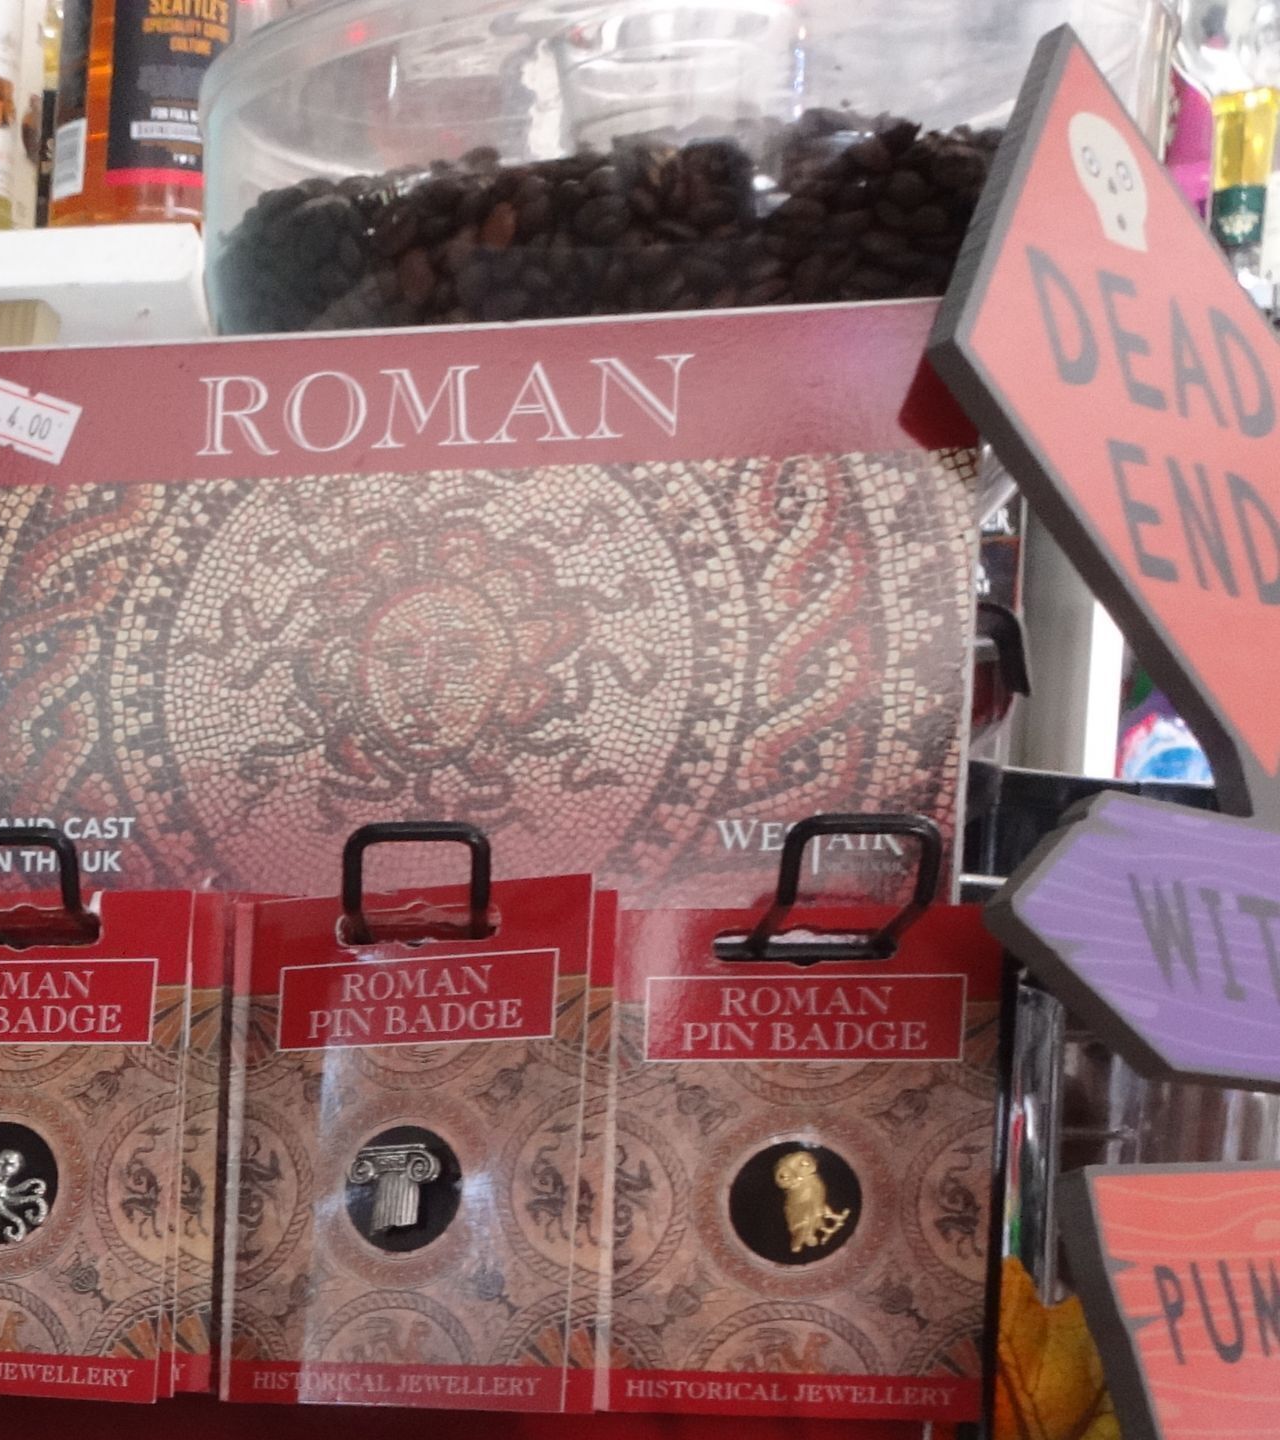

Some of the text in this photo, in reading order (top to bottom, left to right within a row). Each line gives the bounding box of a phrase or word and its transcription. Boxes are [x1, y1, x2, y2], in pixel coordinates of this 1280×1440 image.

[1025, 246, 1277, 439] DEAD
[197, 353, 696, 457] ROMAN
[1106, 439, 1280, 606] END
[64, 817, 136, 839] CAST
[20, 851, 61, 873] TH
[83, 851, 123, 872] UK
[341, 965, 493, 1001] ROMAN
[718, 985, 893, 1017] ROMAN
[308, 999, 523, 1039] PIN BADGE
[681, 1020, 928, 1051] PIN BADGE
[252, 1371, 540, 1397] HISTORICAL JEWELLERY
[626, 1378, 957, 1407] HISTORICAL JEWELLERY
